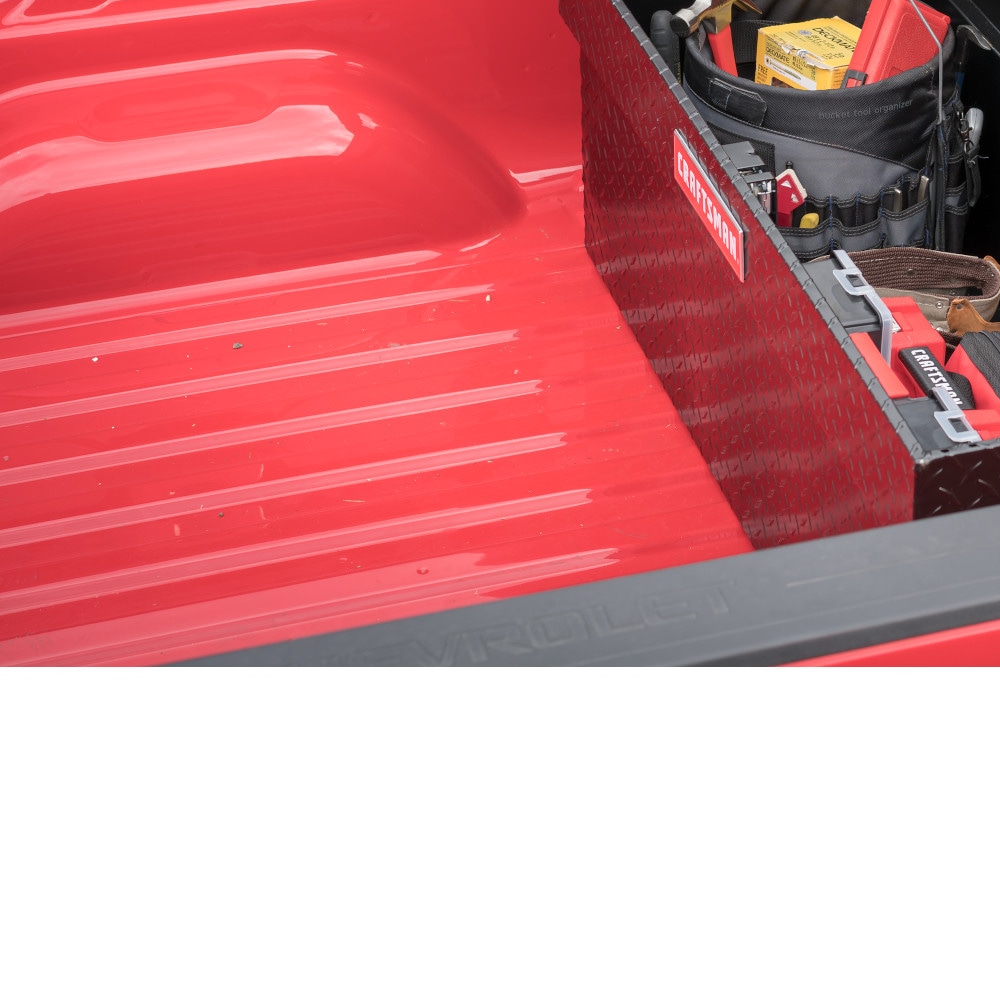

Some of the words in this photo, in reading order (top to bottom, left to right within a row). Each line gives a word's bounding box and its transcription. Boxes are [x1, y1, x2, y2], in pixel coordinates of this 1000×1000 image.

[812, 27, 855, 52] DECKMAT
[818, 111, 851, 120] bucket
[853, 107, 871, 118] tool
[874, 99, 913, 114] organizer
[677, 151, 737, 261] CRAFTSMAN
